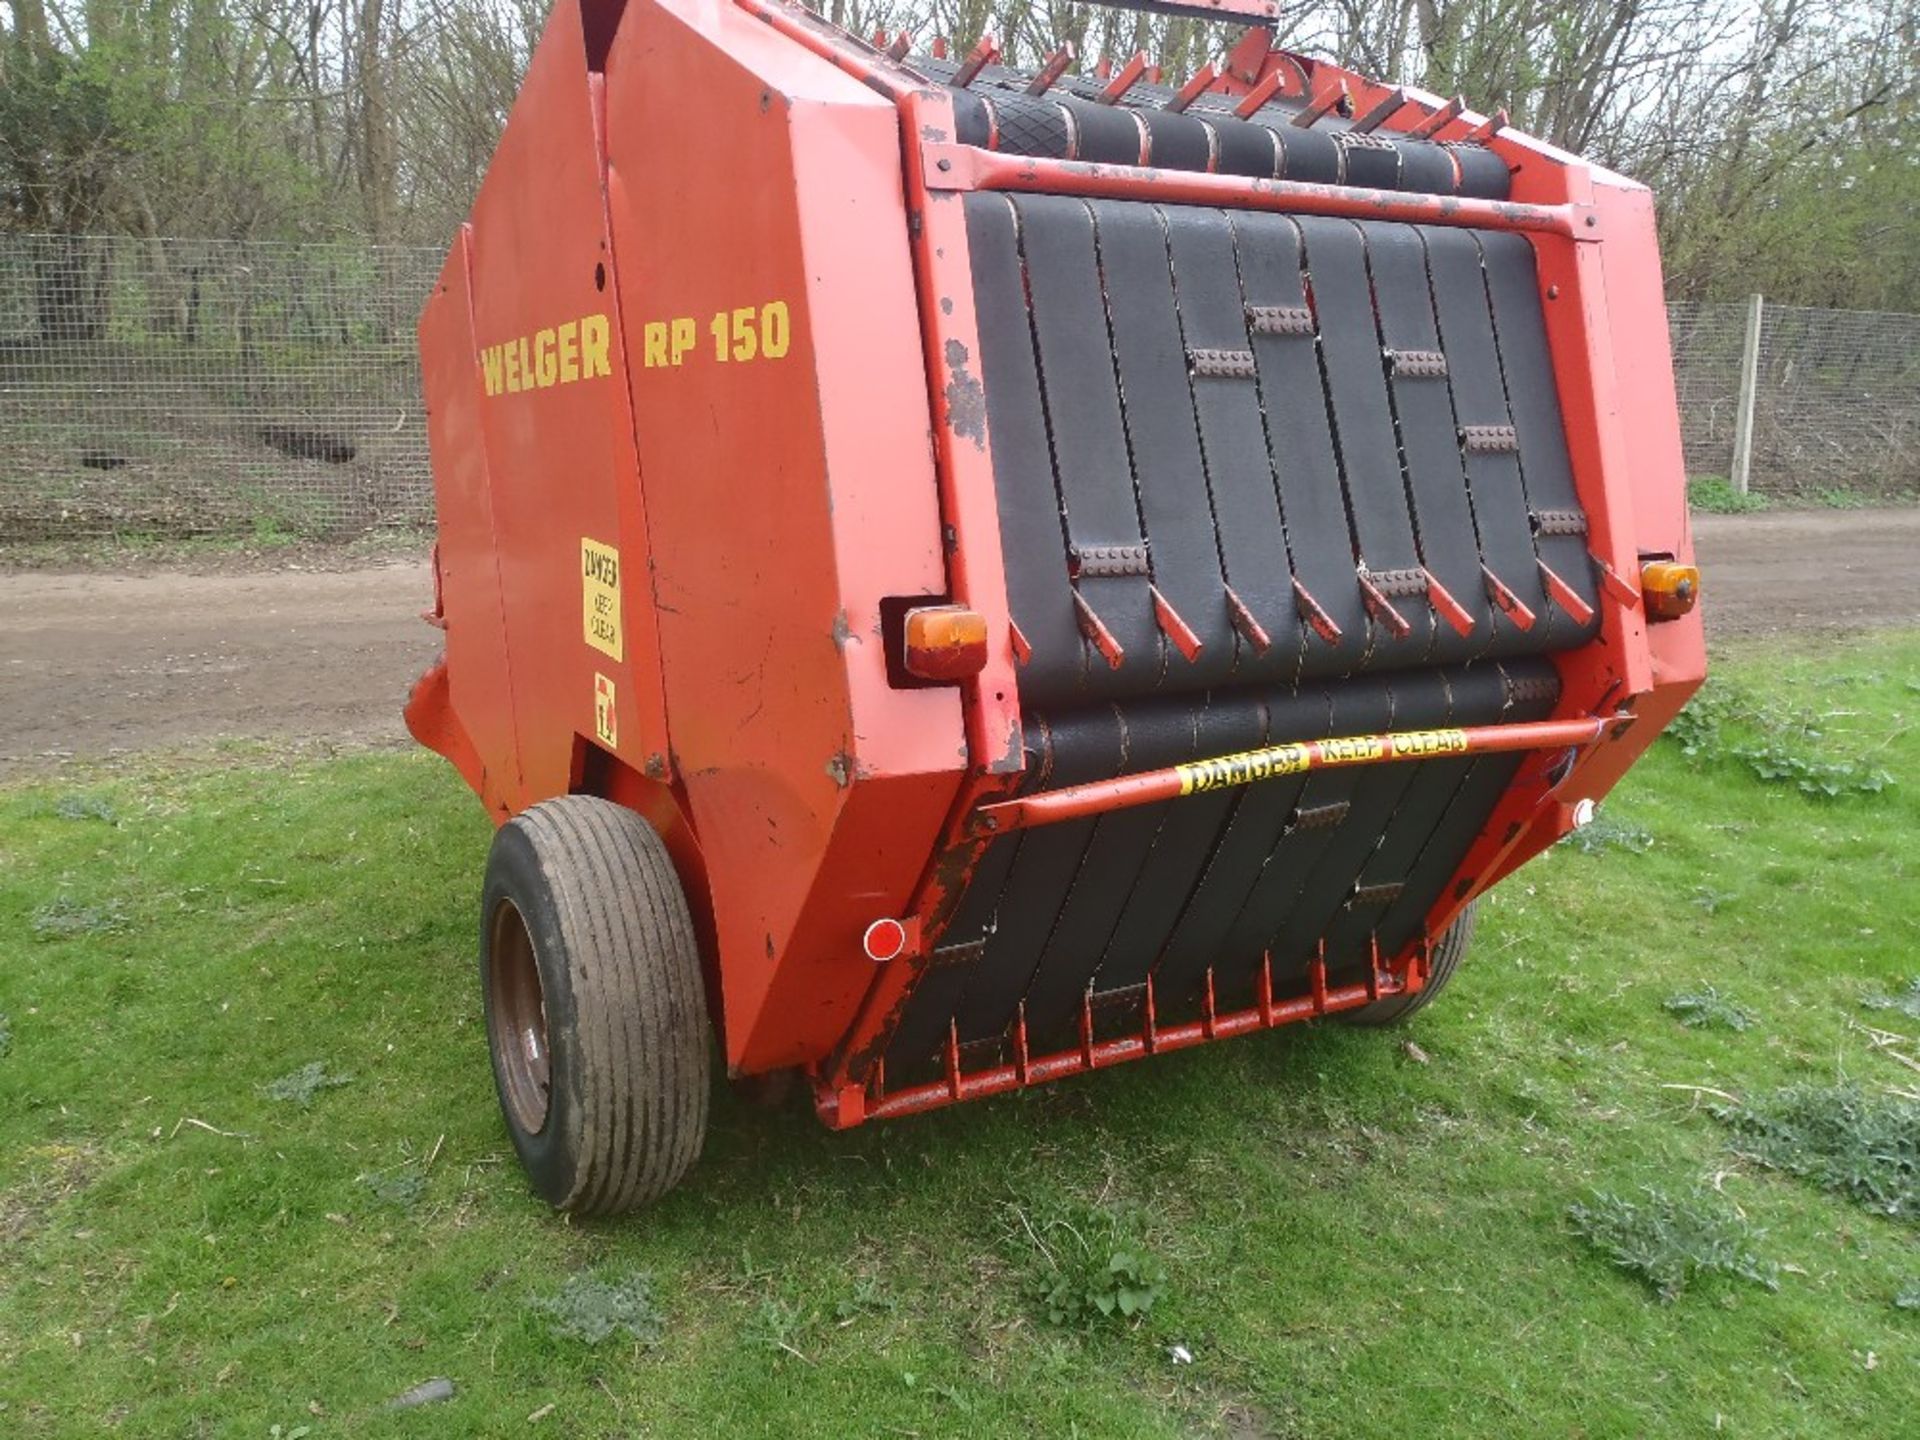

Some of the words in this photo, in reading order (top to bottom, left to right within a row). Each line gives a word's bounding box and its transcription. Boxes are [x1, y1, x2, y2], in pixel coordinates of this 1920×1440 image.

[481, 313, 611, 396] WELGER
[644, 318, 696, 368] RP
[711, 301, 790, 362] 150
[1187, 743, 1303, 791] DANGER
[1319, 736, 1379, 761] KEEP
[1392, 731, 1465, 754] CLEAR
